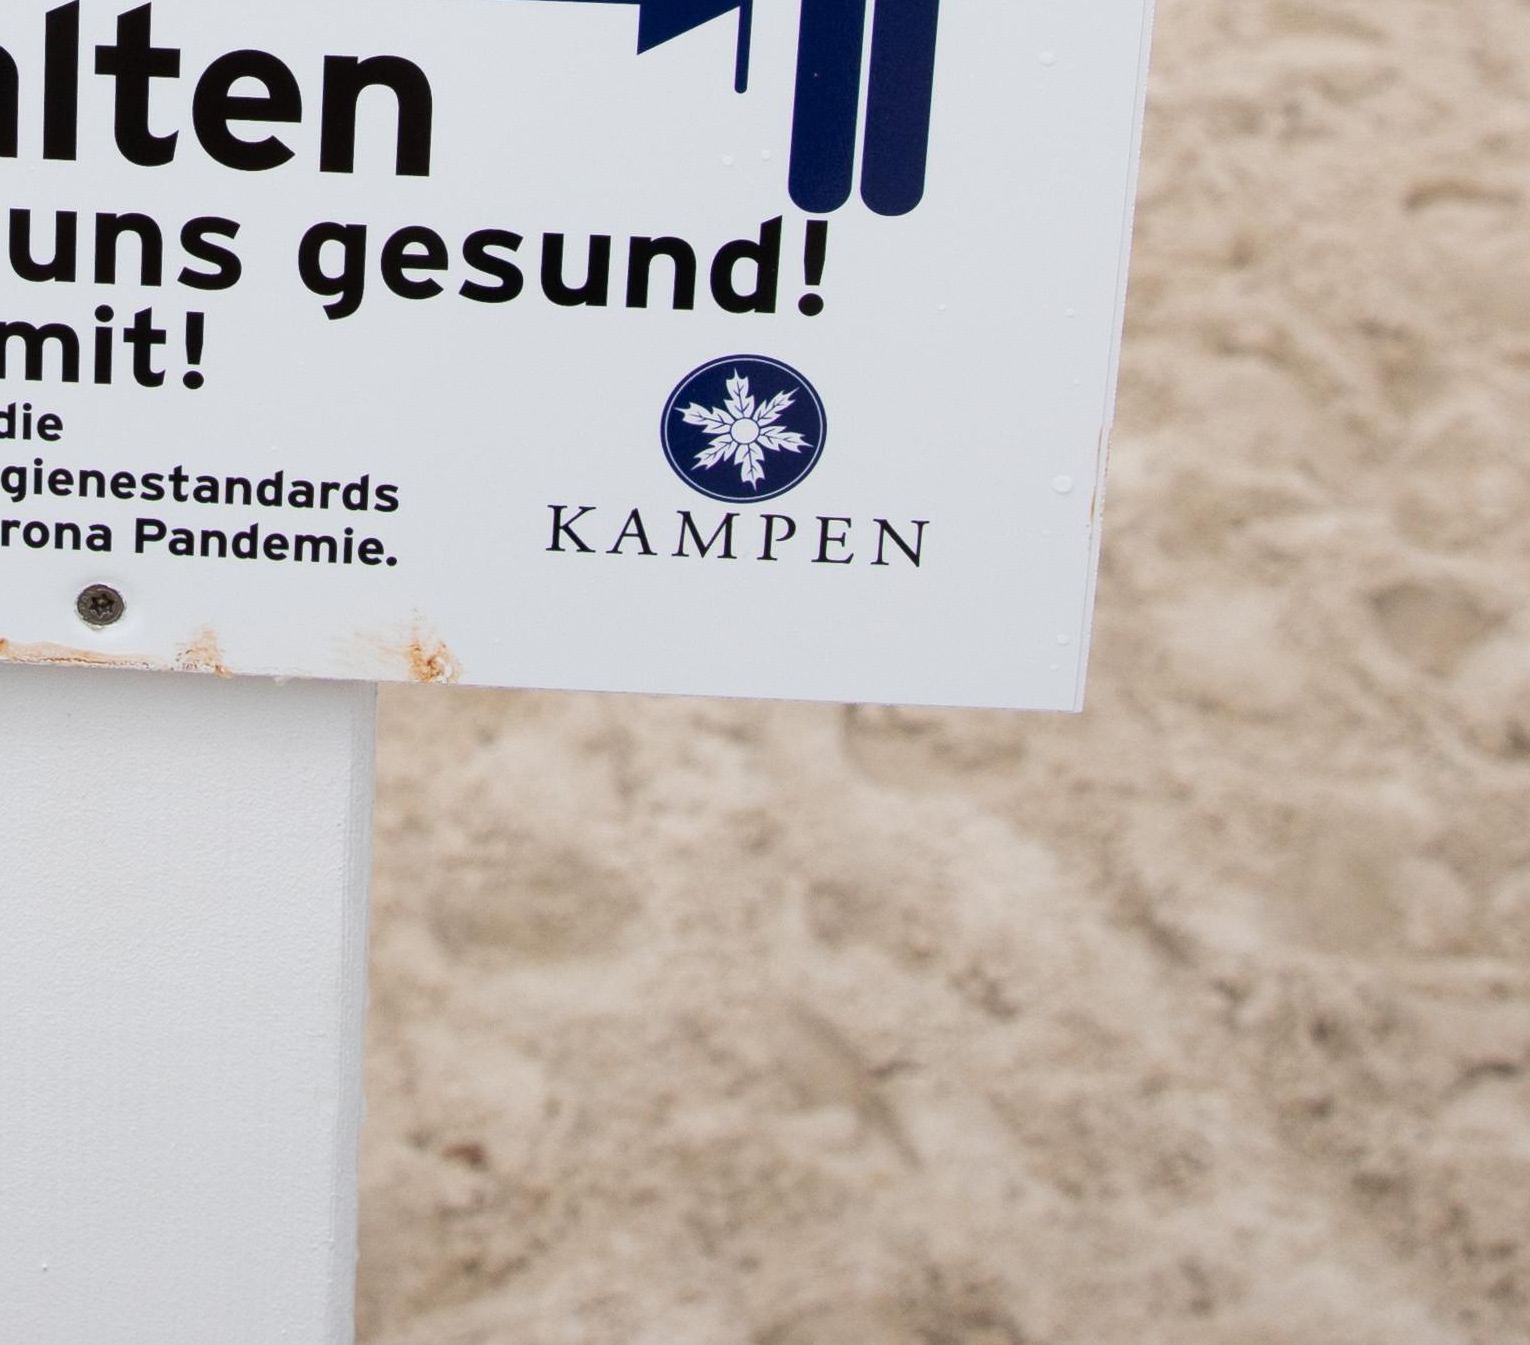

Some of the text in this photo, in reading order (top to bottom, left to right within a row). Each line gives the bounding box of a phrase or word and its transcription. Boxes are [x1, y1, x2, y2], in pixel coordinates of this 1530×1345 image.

[8, 208, 242, 291] uns
[297, 215, 829, 321] gesund!
[134, 517, 398, 567] Pandemie.
[545, 504, 930, 568] KAMPEN
